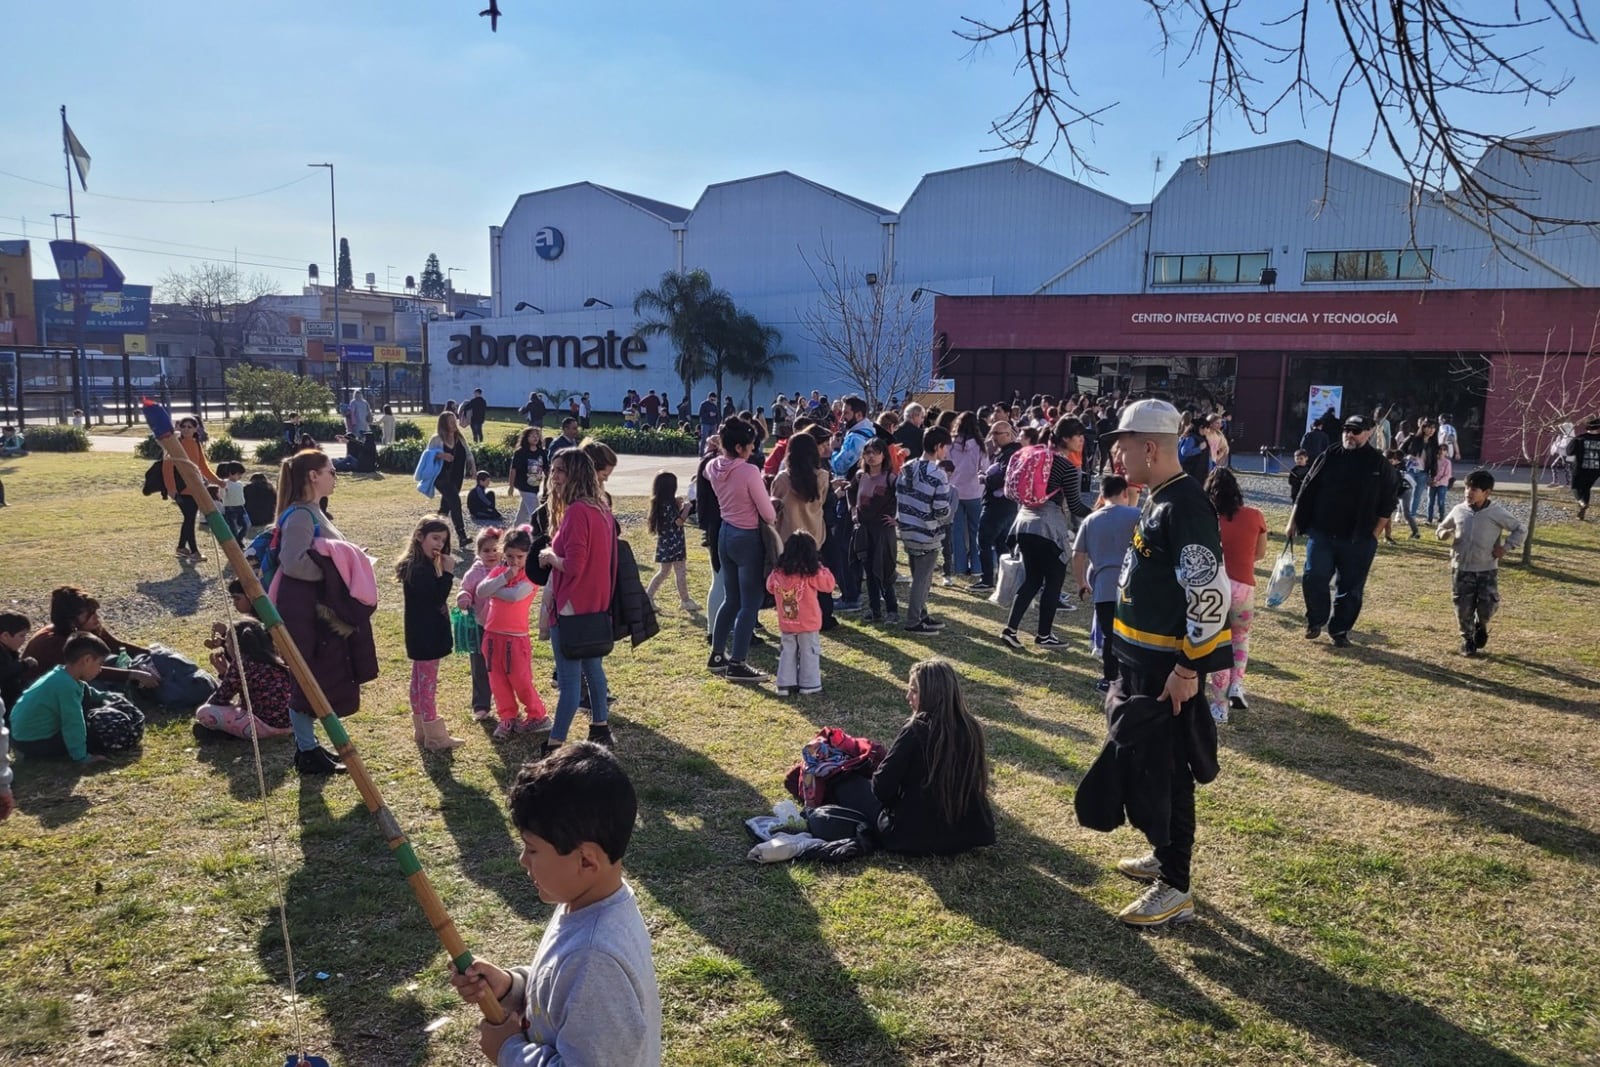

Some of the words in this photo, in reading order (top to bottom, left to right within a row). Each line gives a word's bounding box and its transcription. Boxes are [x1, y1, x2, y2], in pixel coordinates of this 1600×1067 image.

[1131, 313, 1173, 323] CENTRO
[1175, 313, 1245, 323] INTERACTIVO
[1247, 313, 1261, 323] DE
[1264, 313, 1309, 323] CIENCIA
[1312, 313, 1320, 323] Y
[1322, 310, 1399, 324] TECNOLOGÍA
[447, 325, 648, 370] abremate
[1186, 588, 1223, 623] 22
